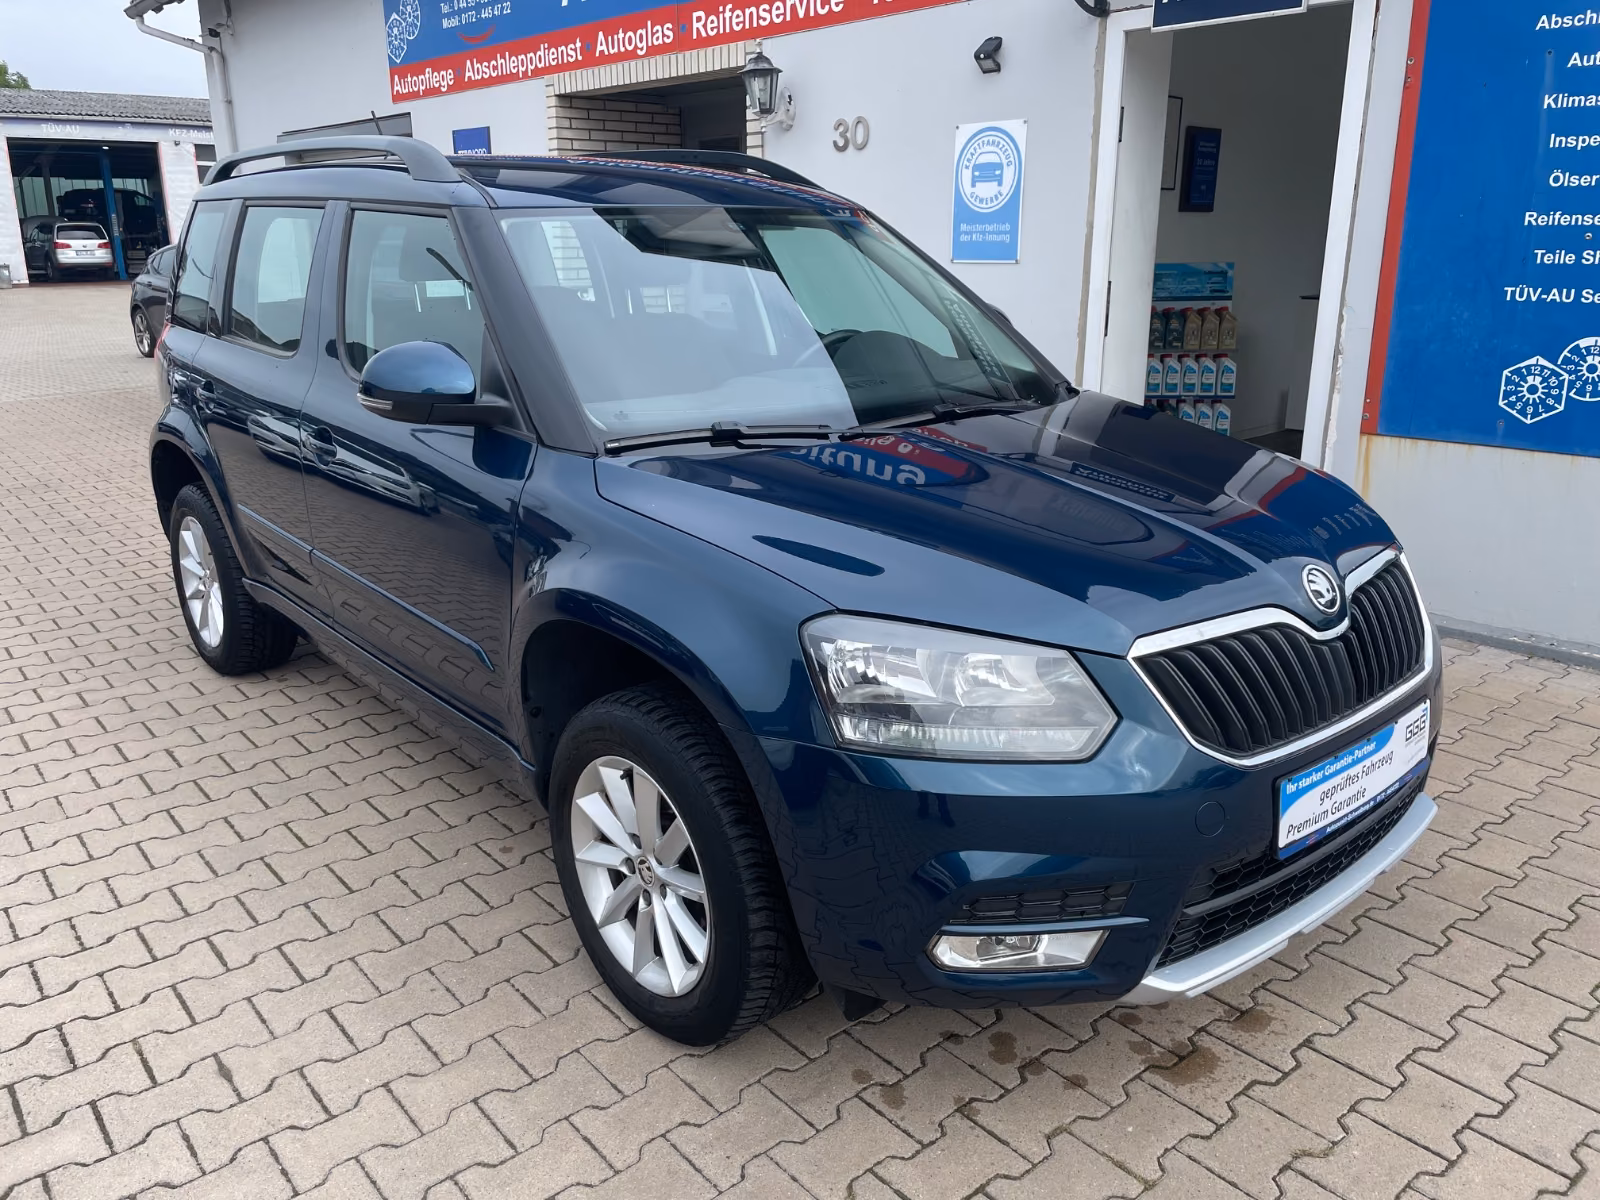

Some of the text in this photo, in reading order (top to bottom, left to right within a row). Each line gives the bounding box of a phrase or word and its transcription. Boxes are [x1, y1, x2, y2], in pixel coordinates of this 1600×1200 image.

[442, 14, 460, 29] Mobil:
[462, 11, 476, 24] 0172
[481, 7, 492, 19] 445
[494, 4, 501, 16] 47
[503, 2, 511, 14] 22
[1535, 10, 1600, 30] Absch
[393, 0, 844, 96] Autopflege Abschleppdienst Autoglas Reifenservice
[832, 115, 869, 152] 30
[1549, 133, 1600, 150] Inspe
[964, 139, 1013, 170] KRAFTFAHRZEUG
[1549, 169, 1600, 187] Ölser
[970, 190, 1003, 206] GEWERBE
[960, 223, 1010, 232] Meisterbetrieb
[972, 233, 1010, 243] Kfz-Innung
[1534, 249, 1576, 264] Teile
[1504, 284, 1575, 302] TÜV-AU
[1286, 741, 1376, 794] Ihr starker Garantie-Partner
[1319, 771, 1360, 806] geprüftes
[1362, 751, 1394, 779] Fahrzeug
[1286, 810, 1329, 839] Premium
[1331, 786, 1367, 815] Garantie
